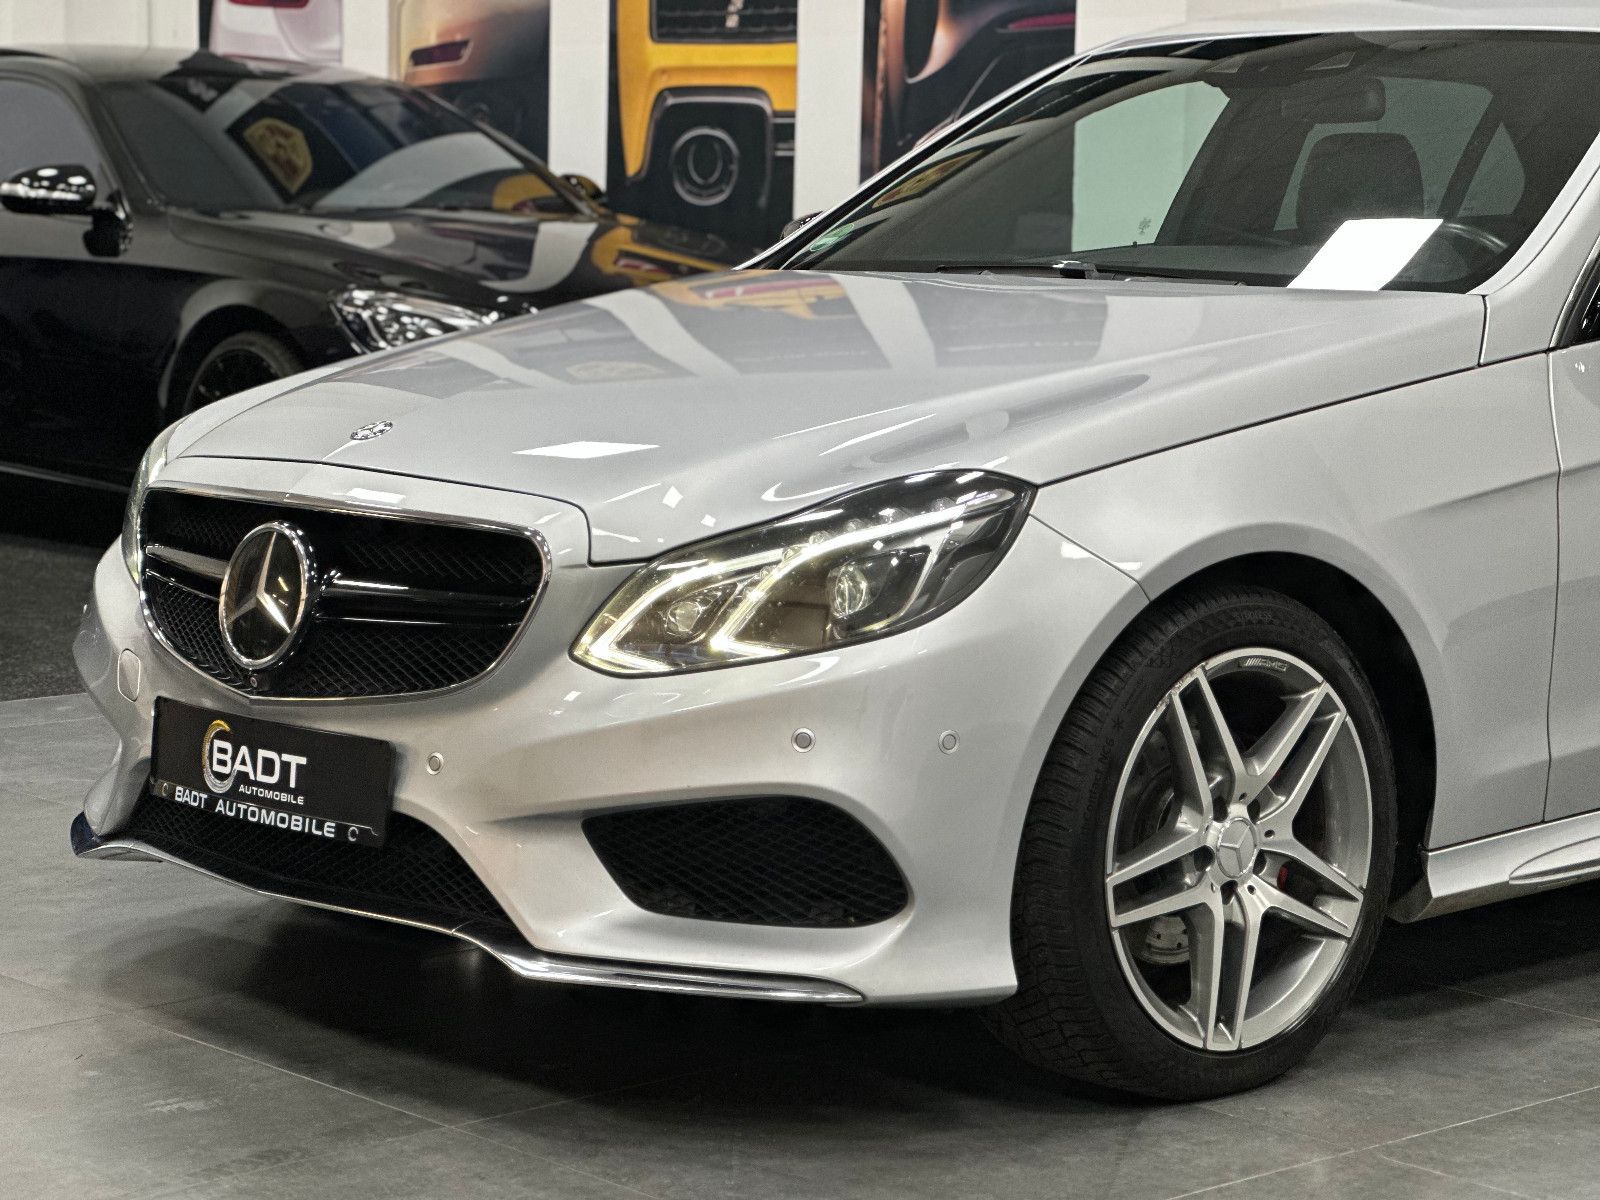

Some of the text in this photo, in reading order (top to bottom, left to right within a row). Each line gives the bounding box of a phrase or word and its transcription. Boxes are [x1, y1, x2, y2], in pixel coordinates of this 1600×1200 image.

[213, 739, 307, 788] BADT
[175, 786, 336, 838] BADT AUTOMOBILE
[238, 784, 305, 805] AUTOMOBILE
